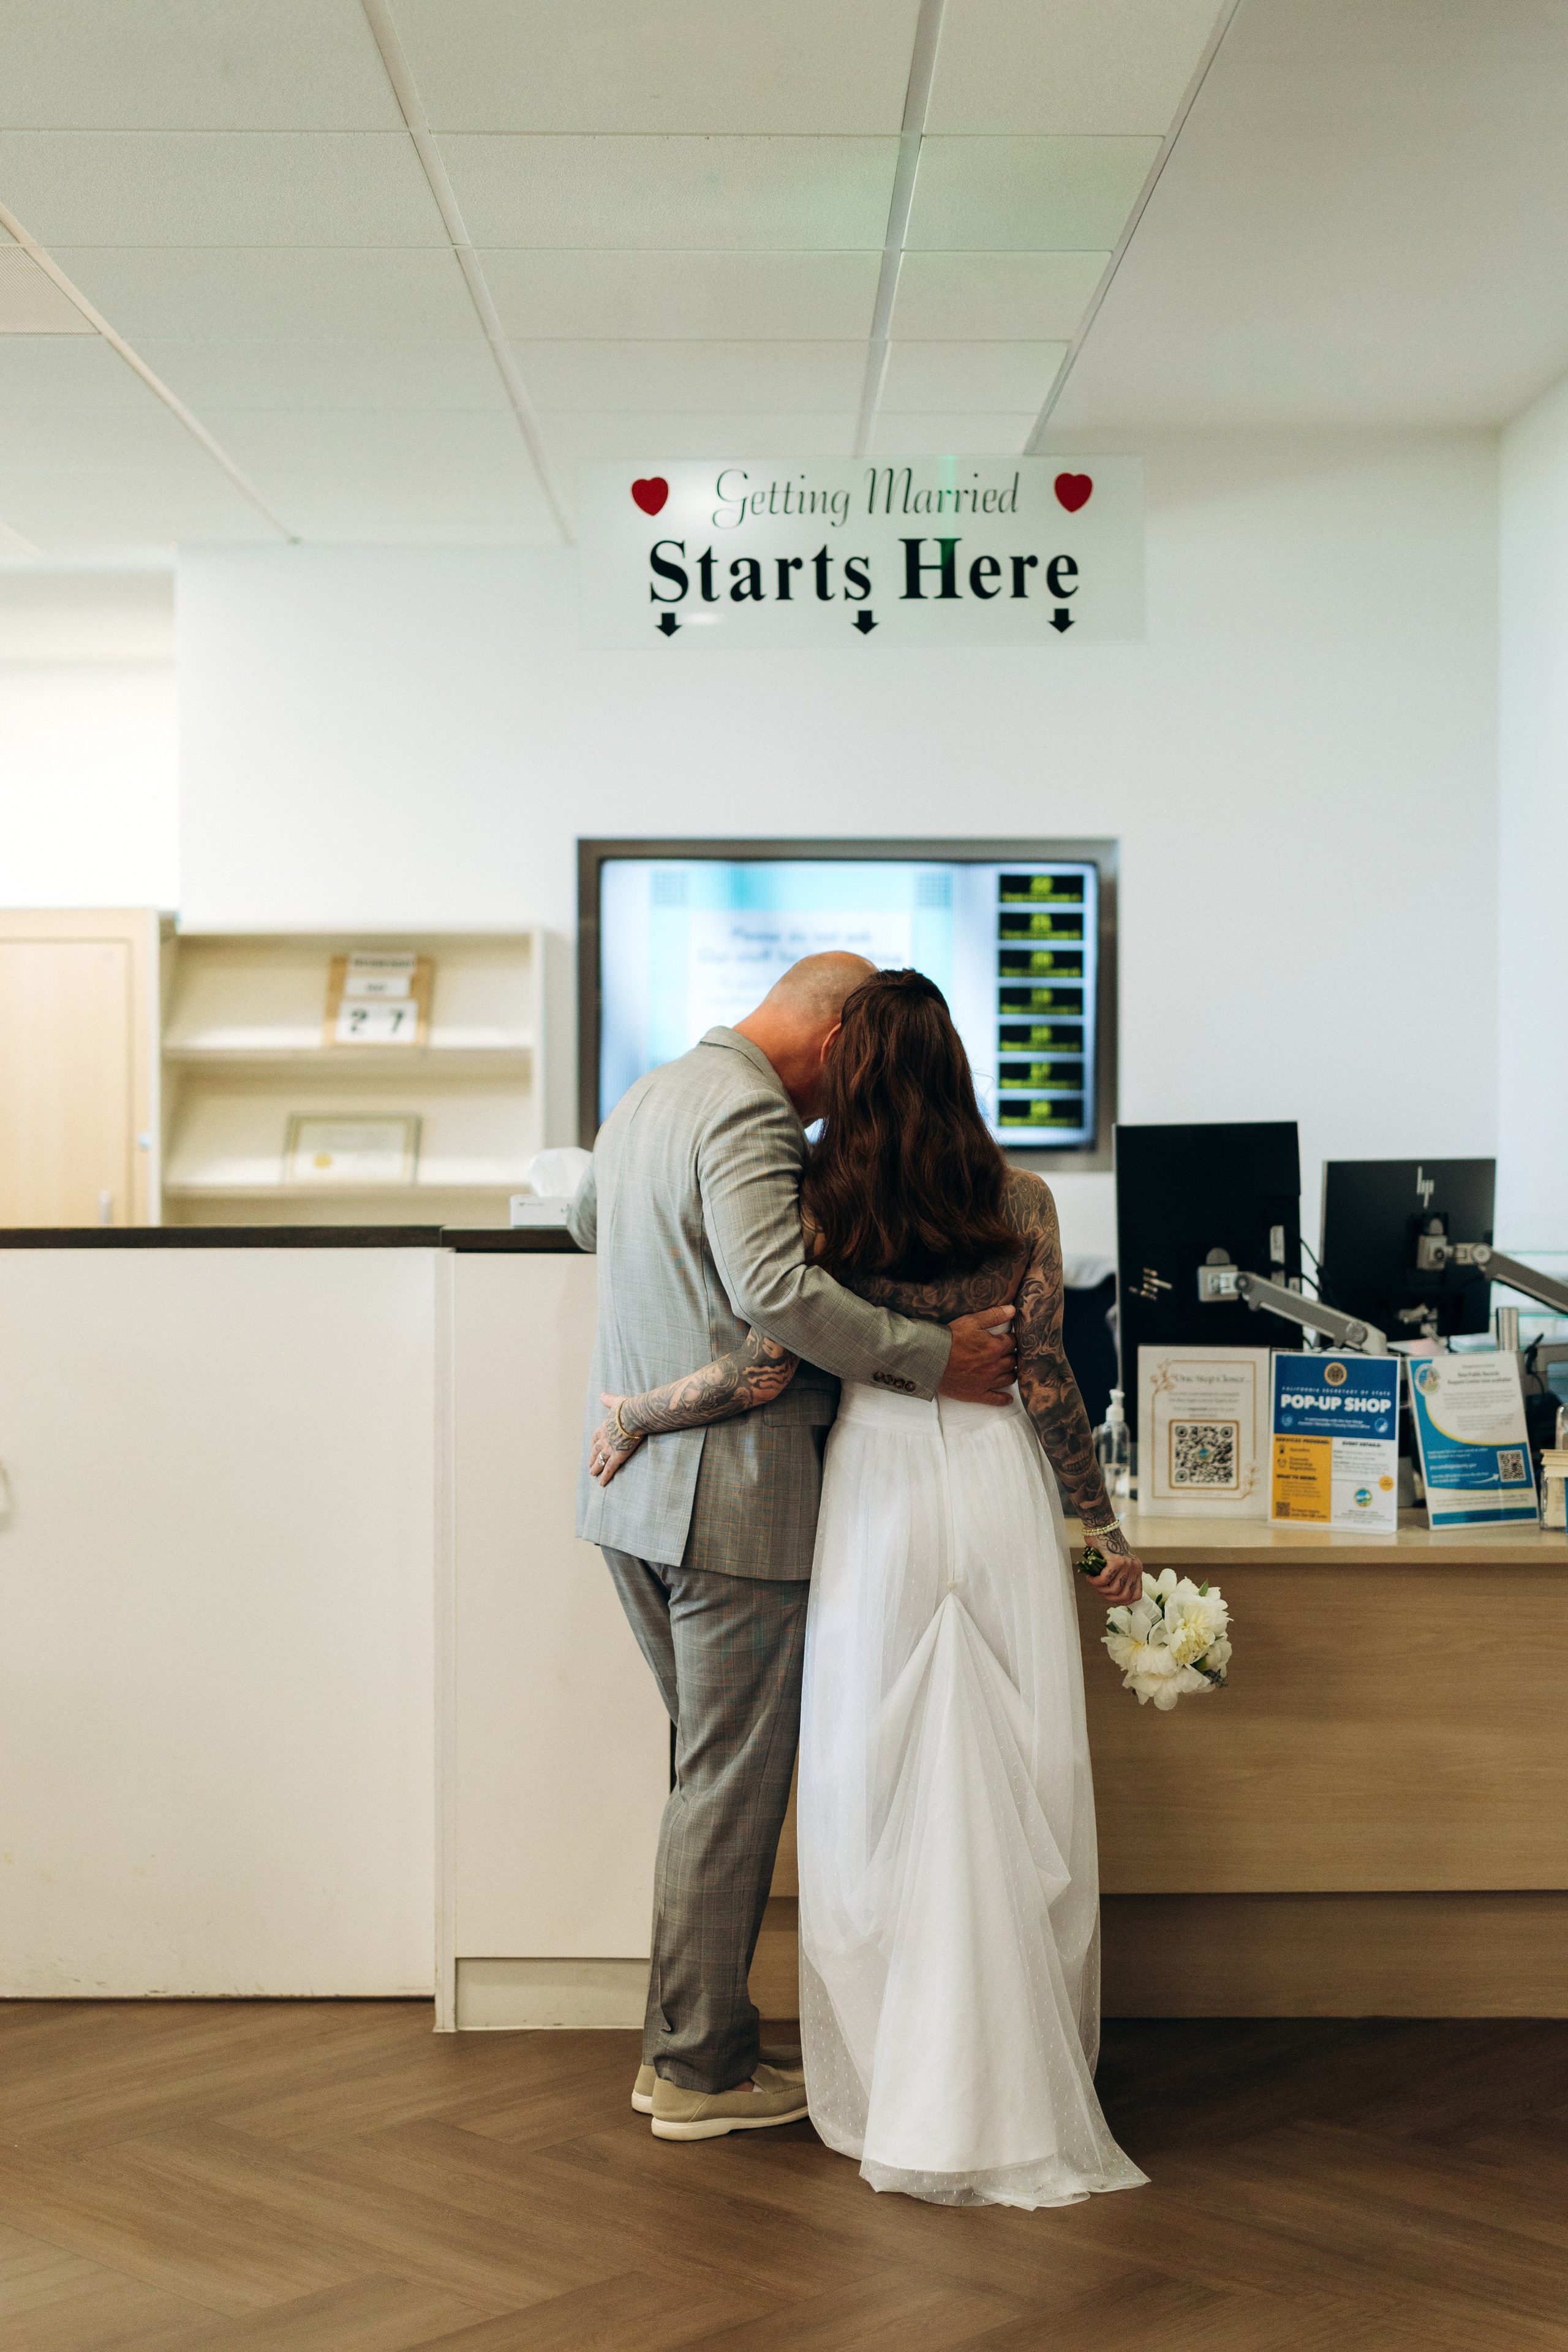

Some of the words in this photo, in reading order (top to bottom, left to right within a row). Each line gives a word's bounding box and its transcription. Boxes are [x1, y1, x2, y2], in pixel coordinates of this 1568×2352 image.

[712, 468, 850, 530] Getting
[863, 467, 1020, 514] Married
[650, 540, 872, 603] Starts
[897, 538, 1079, 600] Here
[1280, 1393, 1342, 1411] POP-UP
[1344, 1396, 1392, 1414] SHOP
